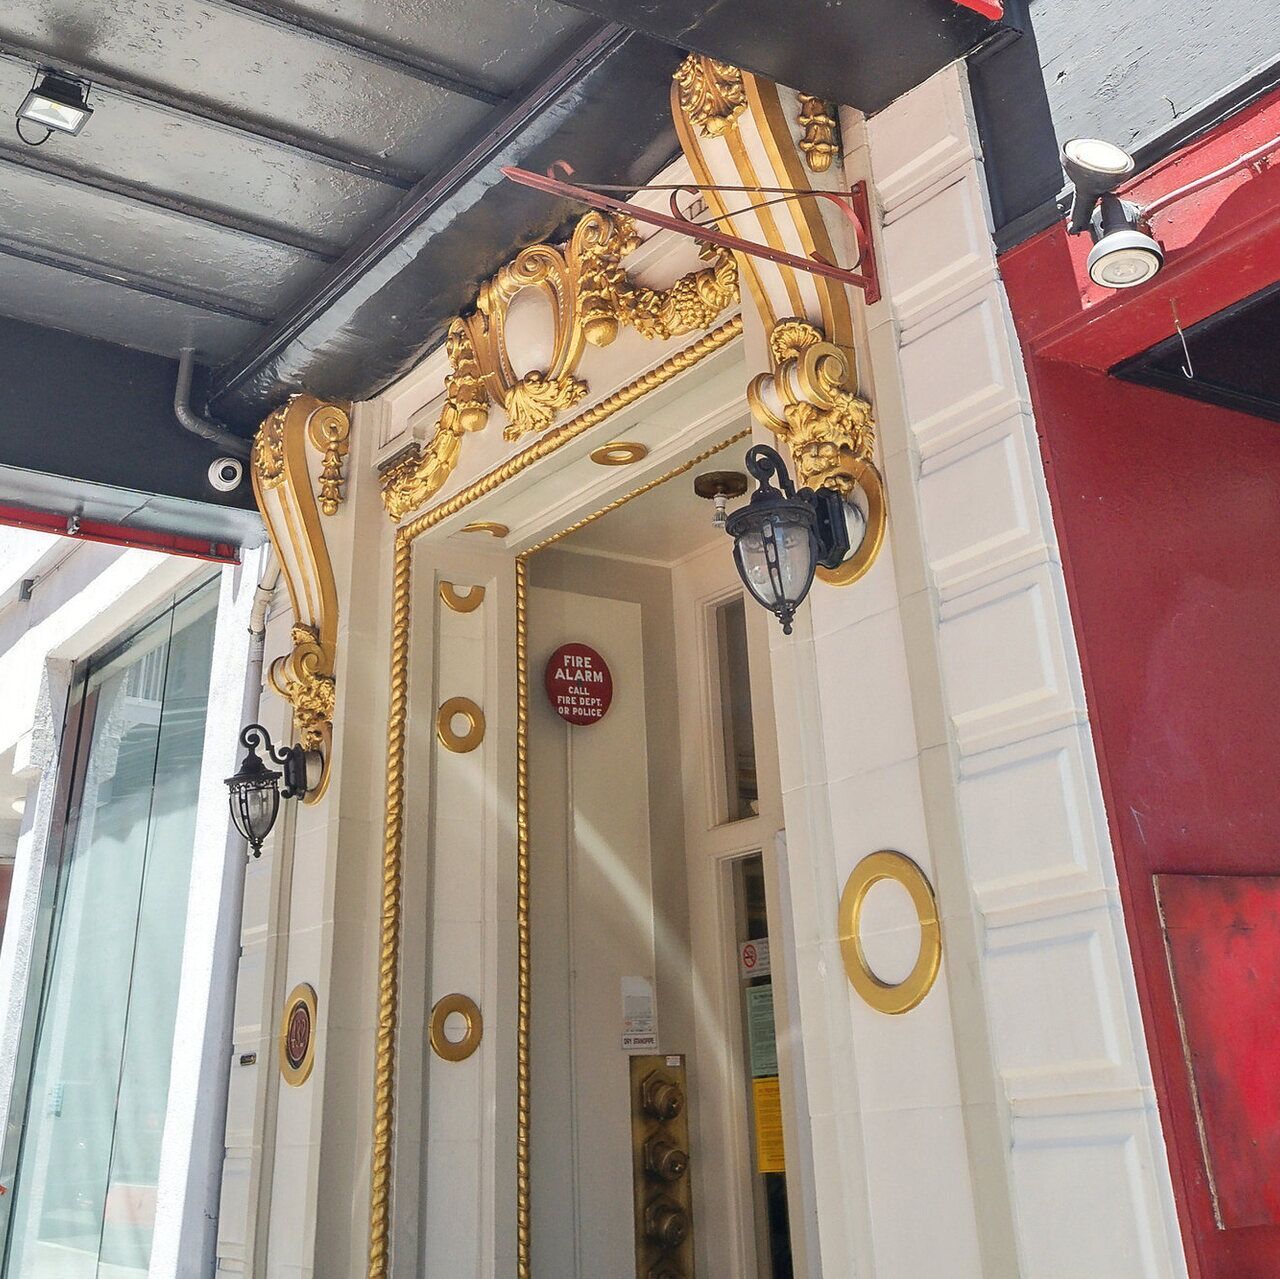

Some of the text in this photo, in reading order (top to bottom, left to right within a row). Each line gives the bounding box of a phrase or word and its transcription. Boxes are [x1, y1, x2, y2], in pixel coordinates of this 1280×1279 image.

[563, 654, 592, 669] FIRE
[554, 668, 603, 683] ALARM
[568, 686, 590, 696] CALL
[557, 696, 602, 707] FIRE DEPT.
[558, 706, 602, 717] OR POLICE
